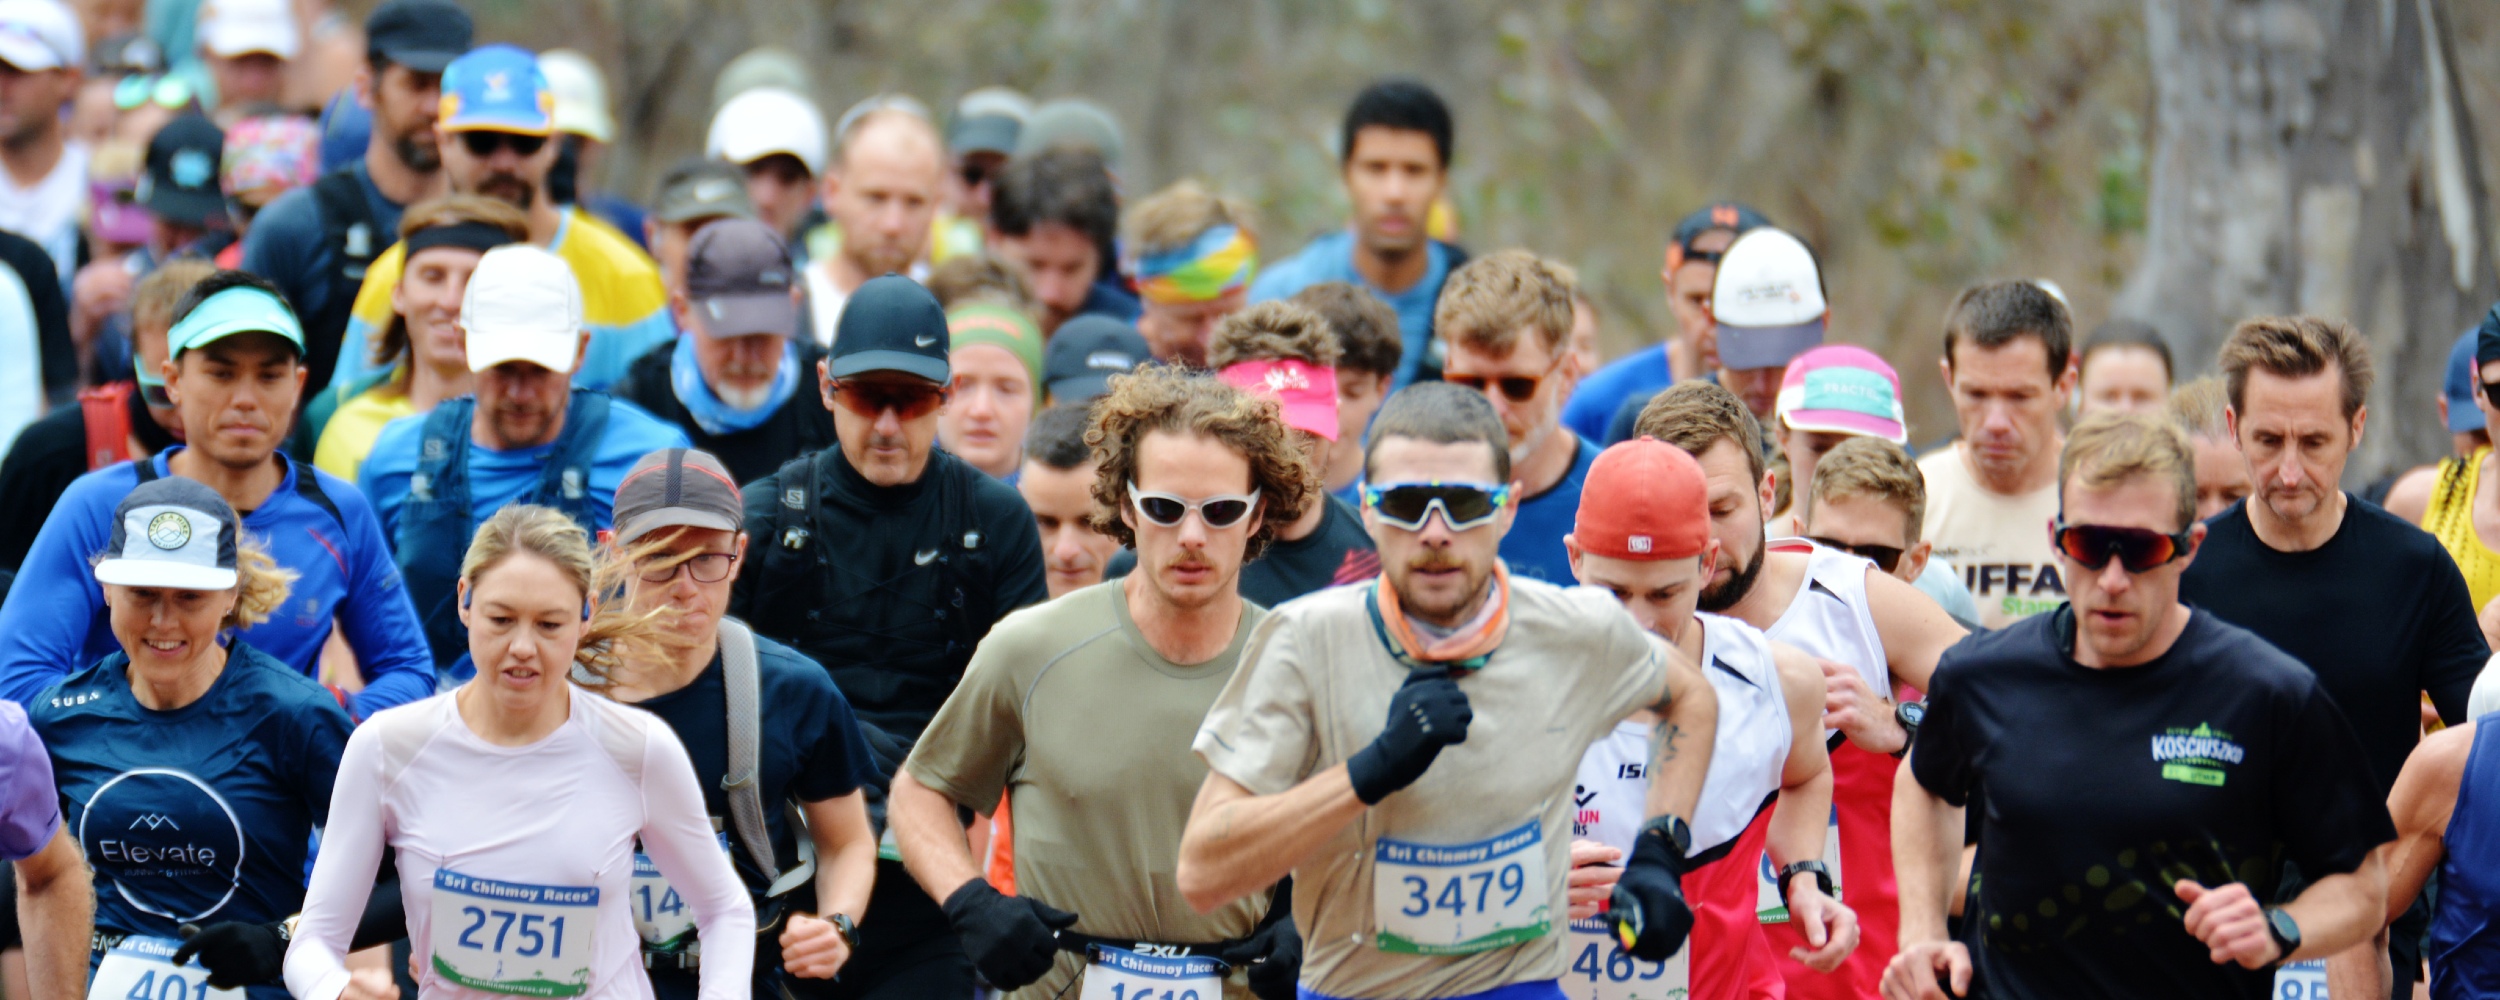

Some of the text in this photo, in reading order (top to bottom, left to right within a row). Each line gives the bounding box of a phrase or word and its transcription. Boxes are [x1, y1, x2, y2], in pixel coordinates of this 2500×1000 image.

[99, 839, 217, 867] Elevate
[444, 874, 590, 903] Sri Chinmoy Races
[1401, 863, 1524, 917] 3479
[457, 906, 565, 959] 2751
[1120, 957, 1183, 978] Chinmoy
